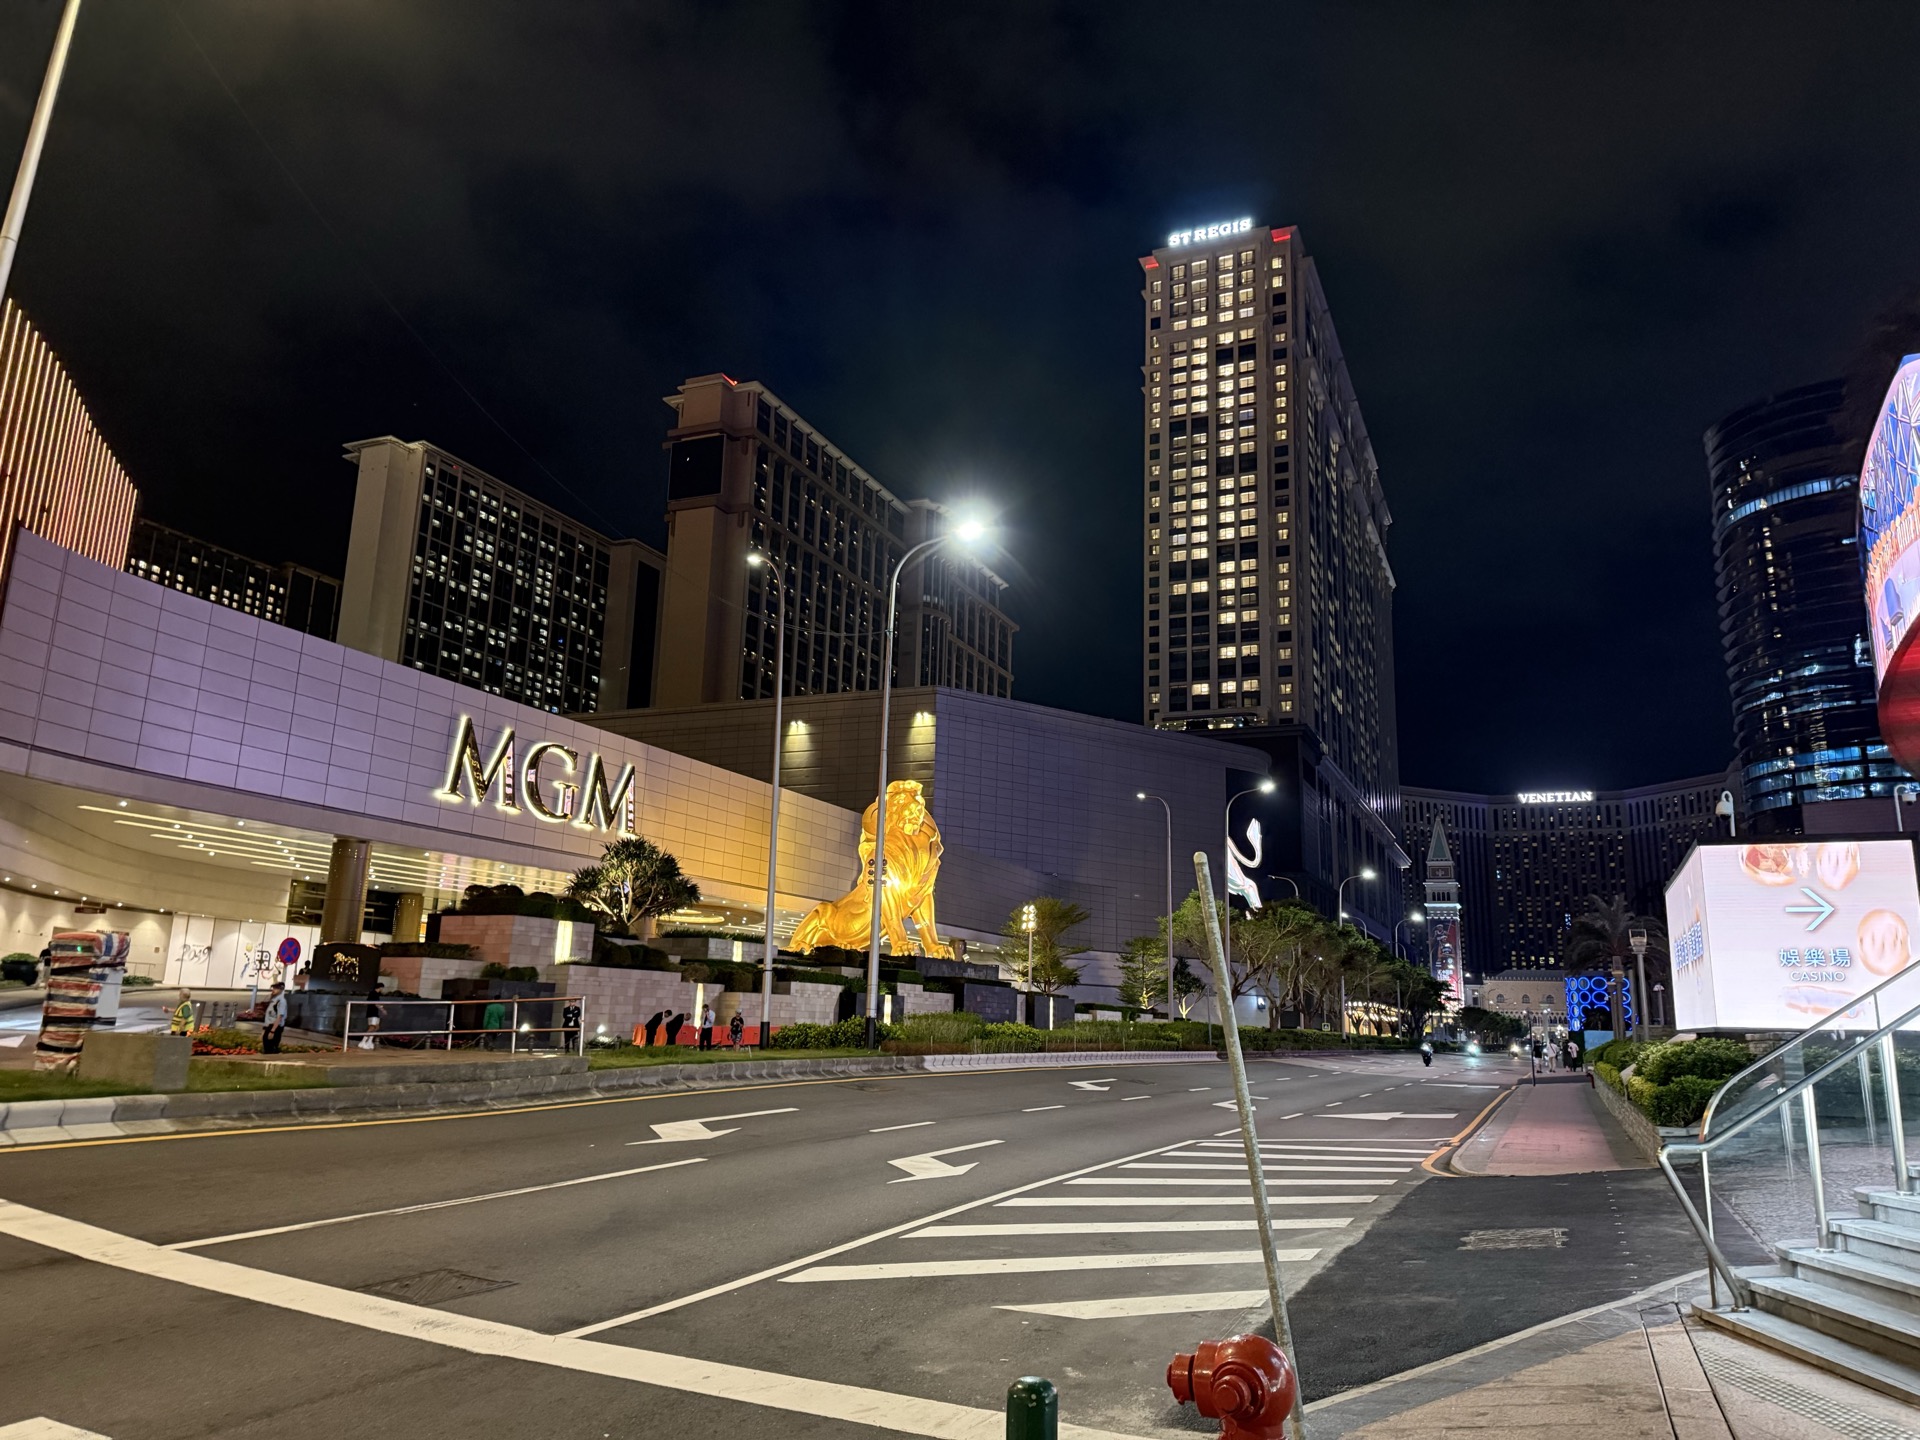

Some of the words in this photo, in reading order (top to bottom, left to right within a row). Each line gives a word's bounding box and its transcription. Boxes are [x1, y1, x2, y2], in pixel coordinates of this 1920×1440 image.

[1193, 217, 1252, 241] REGIS
[434, 715, 639, 839] MGM
[1517, 791, 1593, 804] VENETIAN
[174, 943, 212, 965] 2049
[1779, 948, 1851, 967] 娛樂場
[1790, 970, 1846, 982] CASINO
